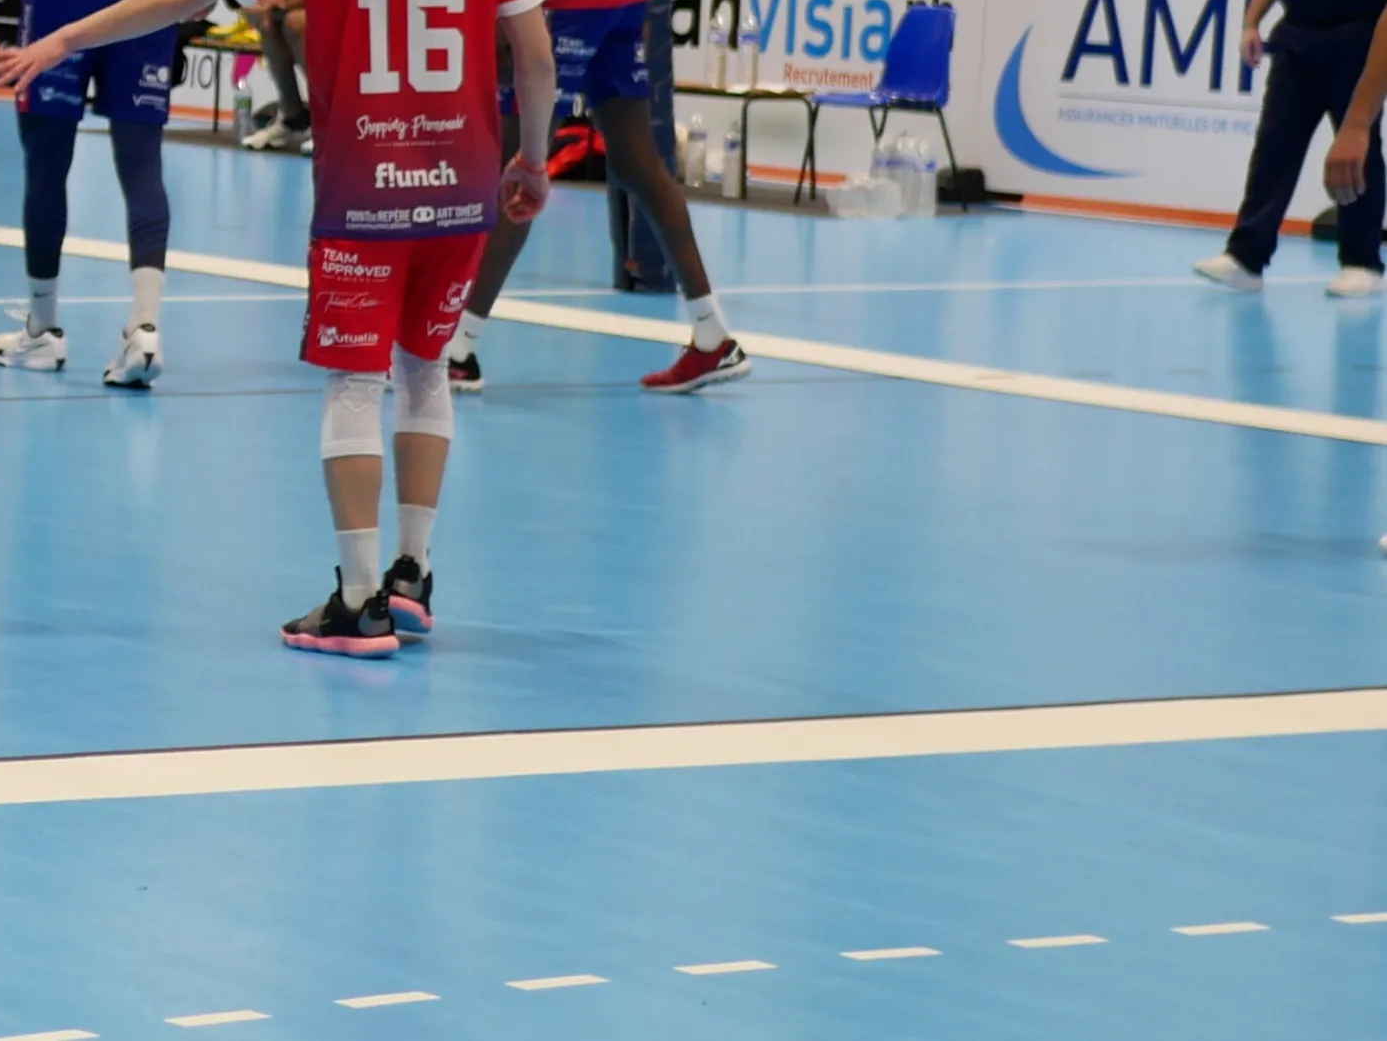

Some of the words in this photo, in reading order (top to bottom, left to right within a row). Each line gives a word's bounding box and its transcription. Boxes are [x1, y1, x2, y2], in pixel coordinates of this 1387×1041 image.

[783, 63, 875, 89] Recrutement
[1058, 106, 1134, 126] ASSURANCES
[1137, 113, 1210, 133] MUTUELLES
[1211, 119, 1228, 133] DE
[323, 247, 360, 263] TEAM
[321, 261, 393, 278] APPROVED
